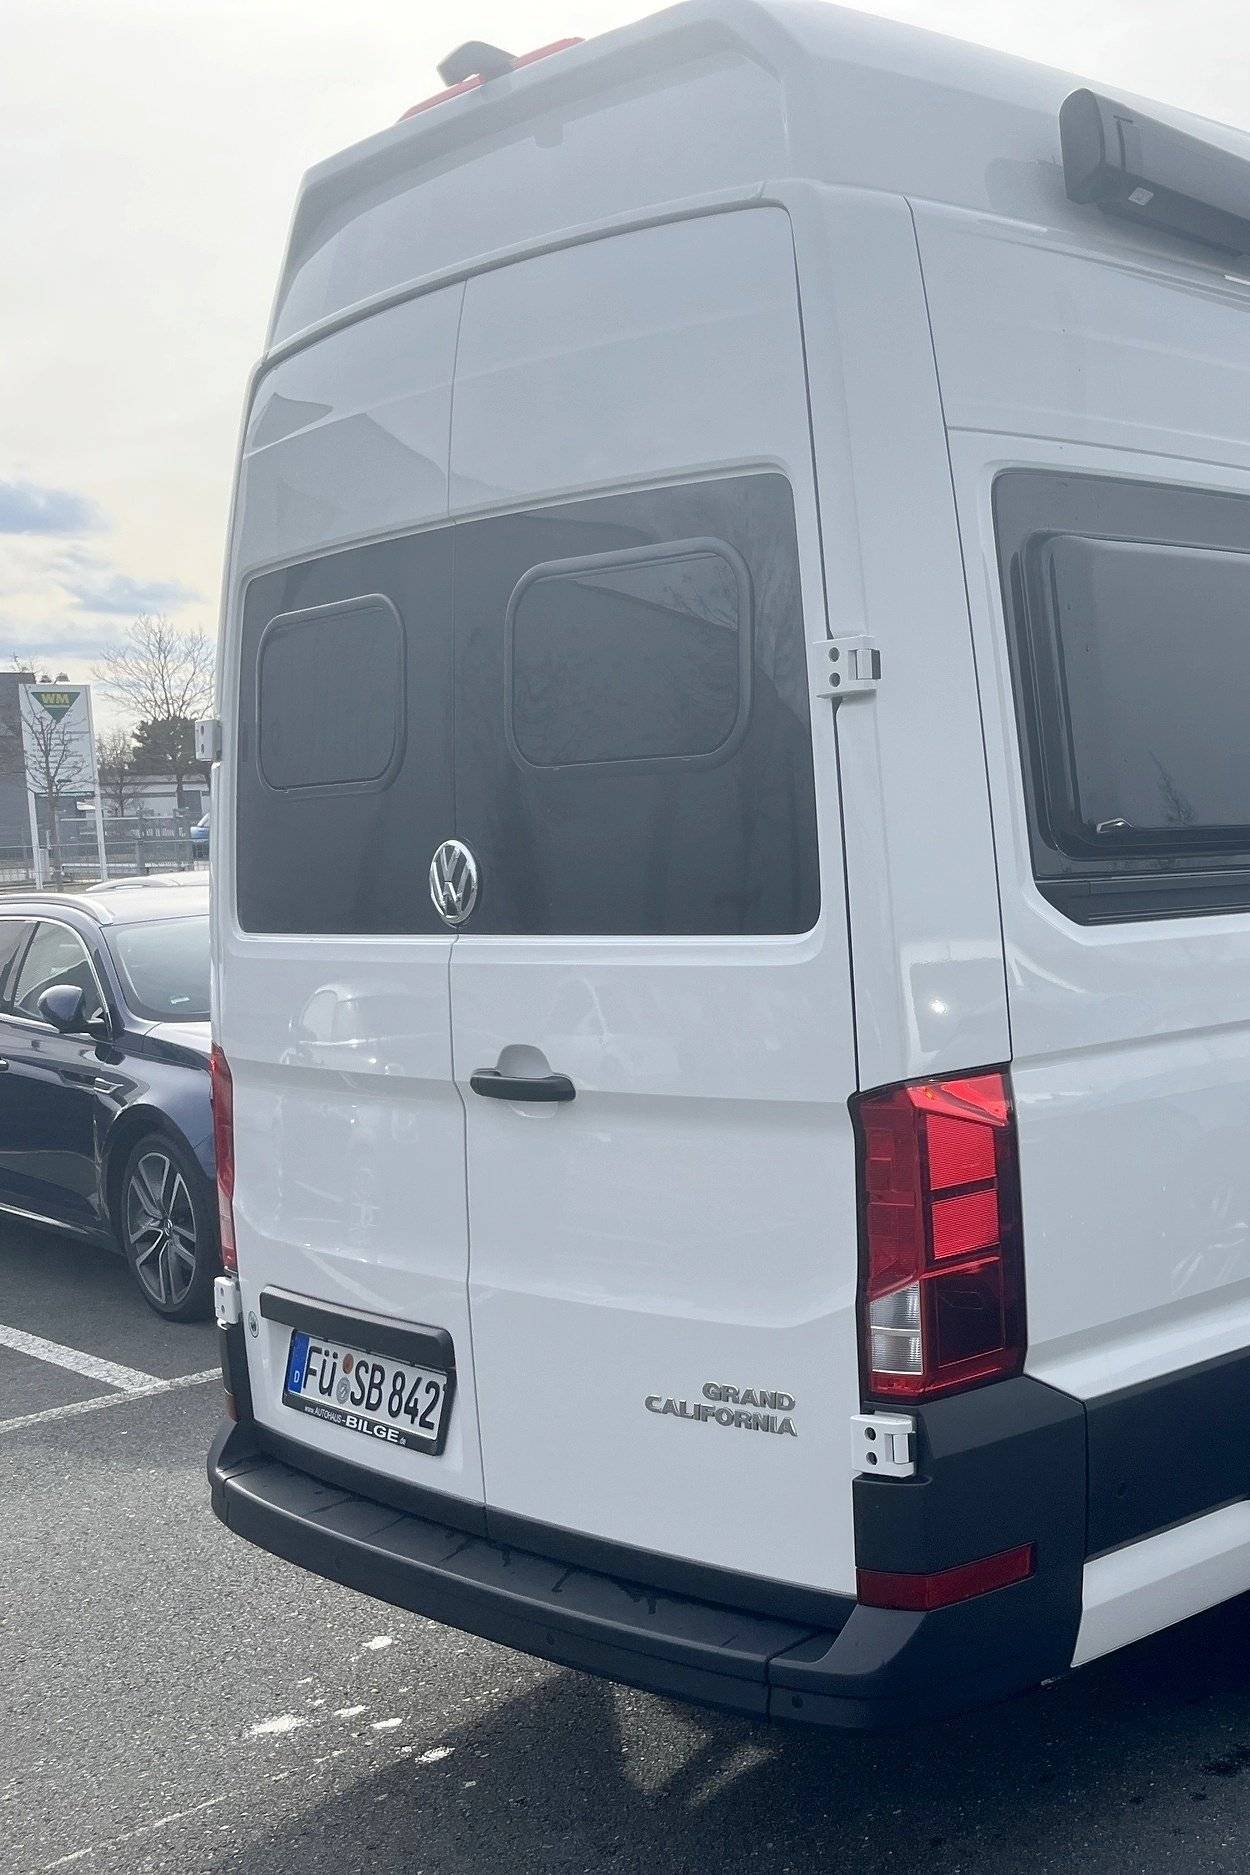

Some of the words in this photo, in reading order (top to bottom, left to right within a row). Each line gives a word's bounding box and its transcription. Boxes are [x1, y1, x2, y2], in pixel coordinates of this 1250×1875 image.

[293, 1370, 301, 1383] D
[303, 1346, 338, 1396] FÜ
[350, 1360, 386, 1411] SB
[388, 1370, 440, 1430] 842
[702, 1382, 795, 1410] GRAND
[645, 1395, 797, 1436] CALIFORNIA
